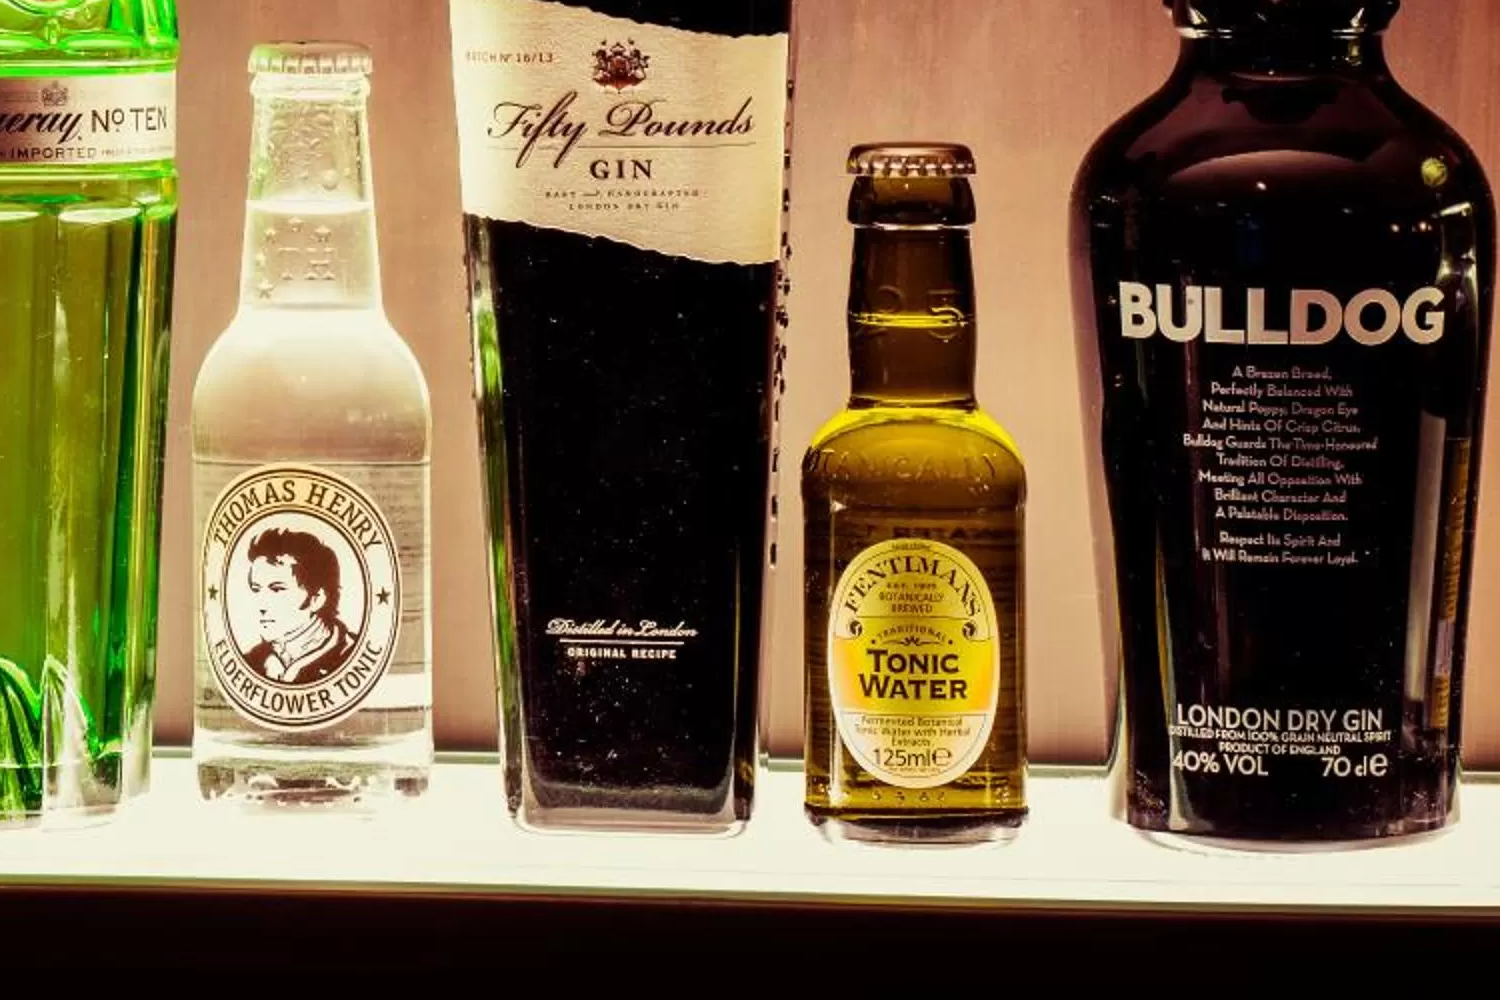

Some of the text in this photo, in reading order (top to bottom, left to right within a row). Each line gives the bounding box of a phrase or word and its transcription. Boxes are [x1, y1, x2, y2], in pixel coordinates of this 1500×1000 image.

[129, 106, 168, 132] TEN
[487, 90, 754, 169] Fifty Pounds
[10, 146, 98, 160] IMPORTED
[589, 159, 654, 181] GIN
[1118, 280, 1446, 346] BULLDOG
[1231, 365, 1244, 379] A
[1210, 381, 1264, 399] Perfectly
[1202, 399, 1245, 413] Natural
[1337, 402, 1359, 419] Eye
[1201, 417, 1227, 431] And
[1263, 419, 1283, 432] Of
[1183, 433, 1224, 451] Bulldog
[1269, 454, 1289, 468] Of
[1247, 471, 1265, 486] All
[1322, 489, 1347, 503] And
[211, 479, 383, 550] THOMAS HENRY
[1214, 505, 1226, 519] A
[1219, 531, 1265, 547] Respect
[1283, 533, 1316, 548] Spirit
[1317, 533, 1341, 547] And
[1212, 547, 1236, 562] Will
[843, 554, 982, 617] FENTIMANS
[616, 623, 635, 637] in
[633, 619, 700, 638] London
[566, 647, 677, 660] ORIGINAL RECIPE
[213, 638, 383, 713] ELDERFLOWER TONIC
[1177, 703, 1383, 732] LONDON DRY GIN
[1215, 729, 1246, 741] FROM
[1247, 730, 1279, 742] 100%
[1281, 731, 1315, 743] GRAIN
[1218, 741, 1270, 754] PRODUCT
[1271, 744, 1288, 755] OF
[1172, 749, 1269, 776] 40% VOL
[1321, 756, 1351, 777] 70
